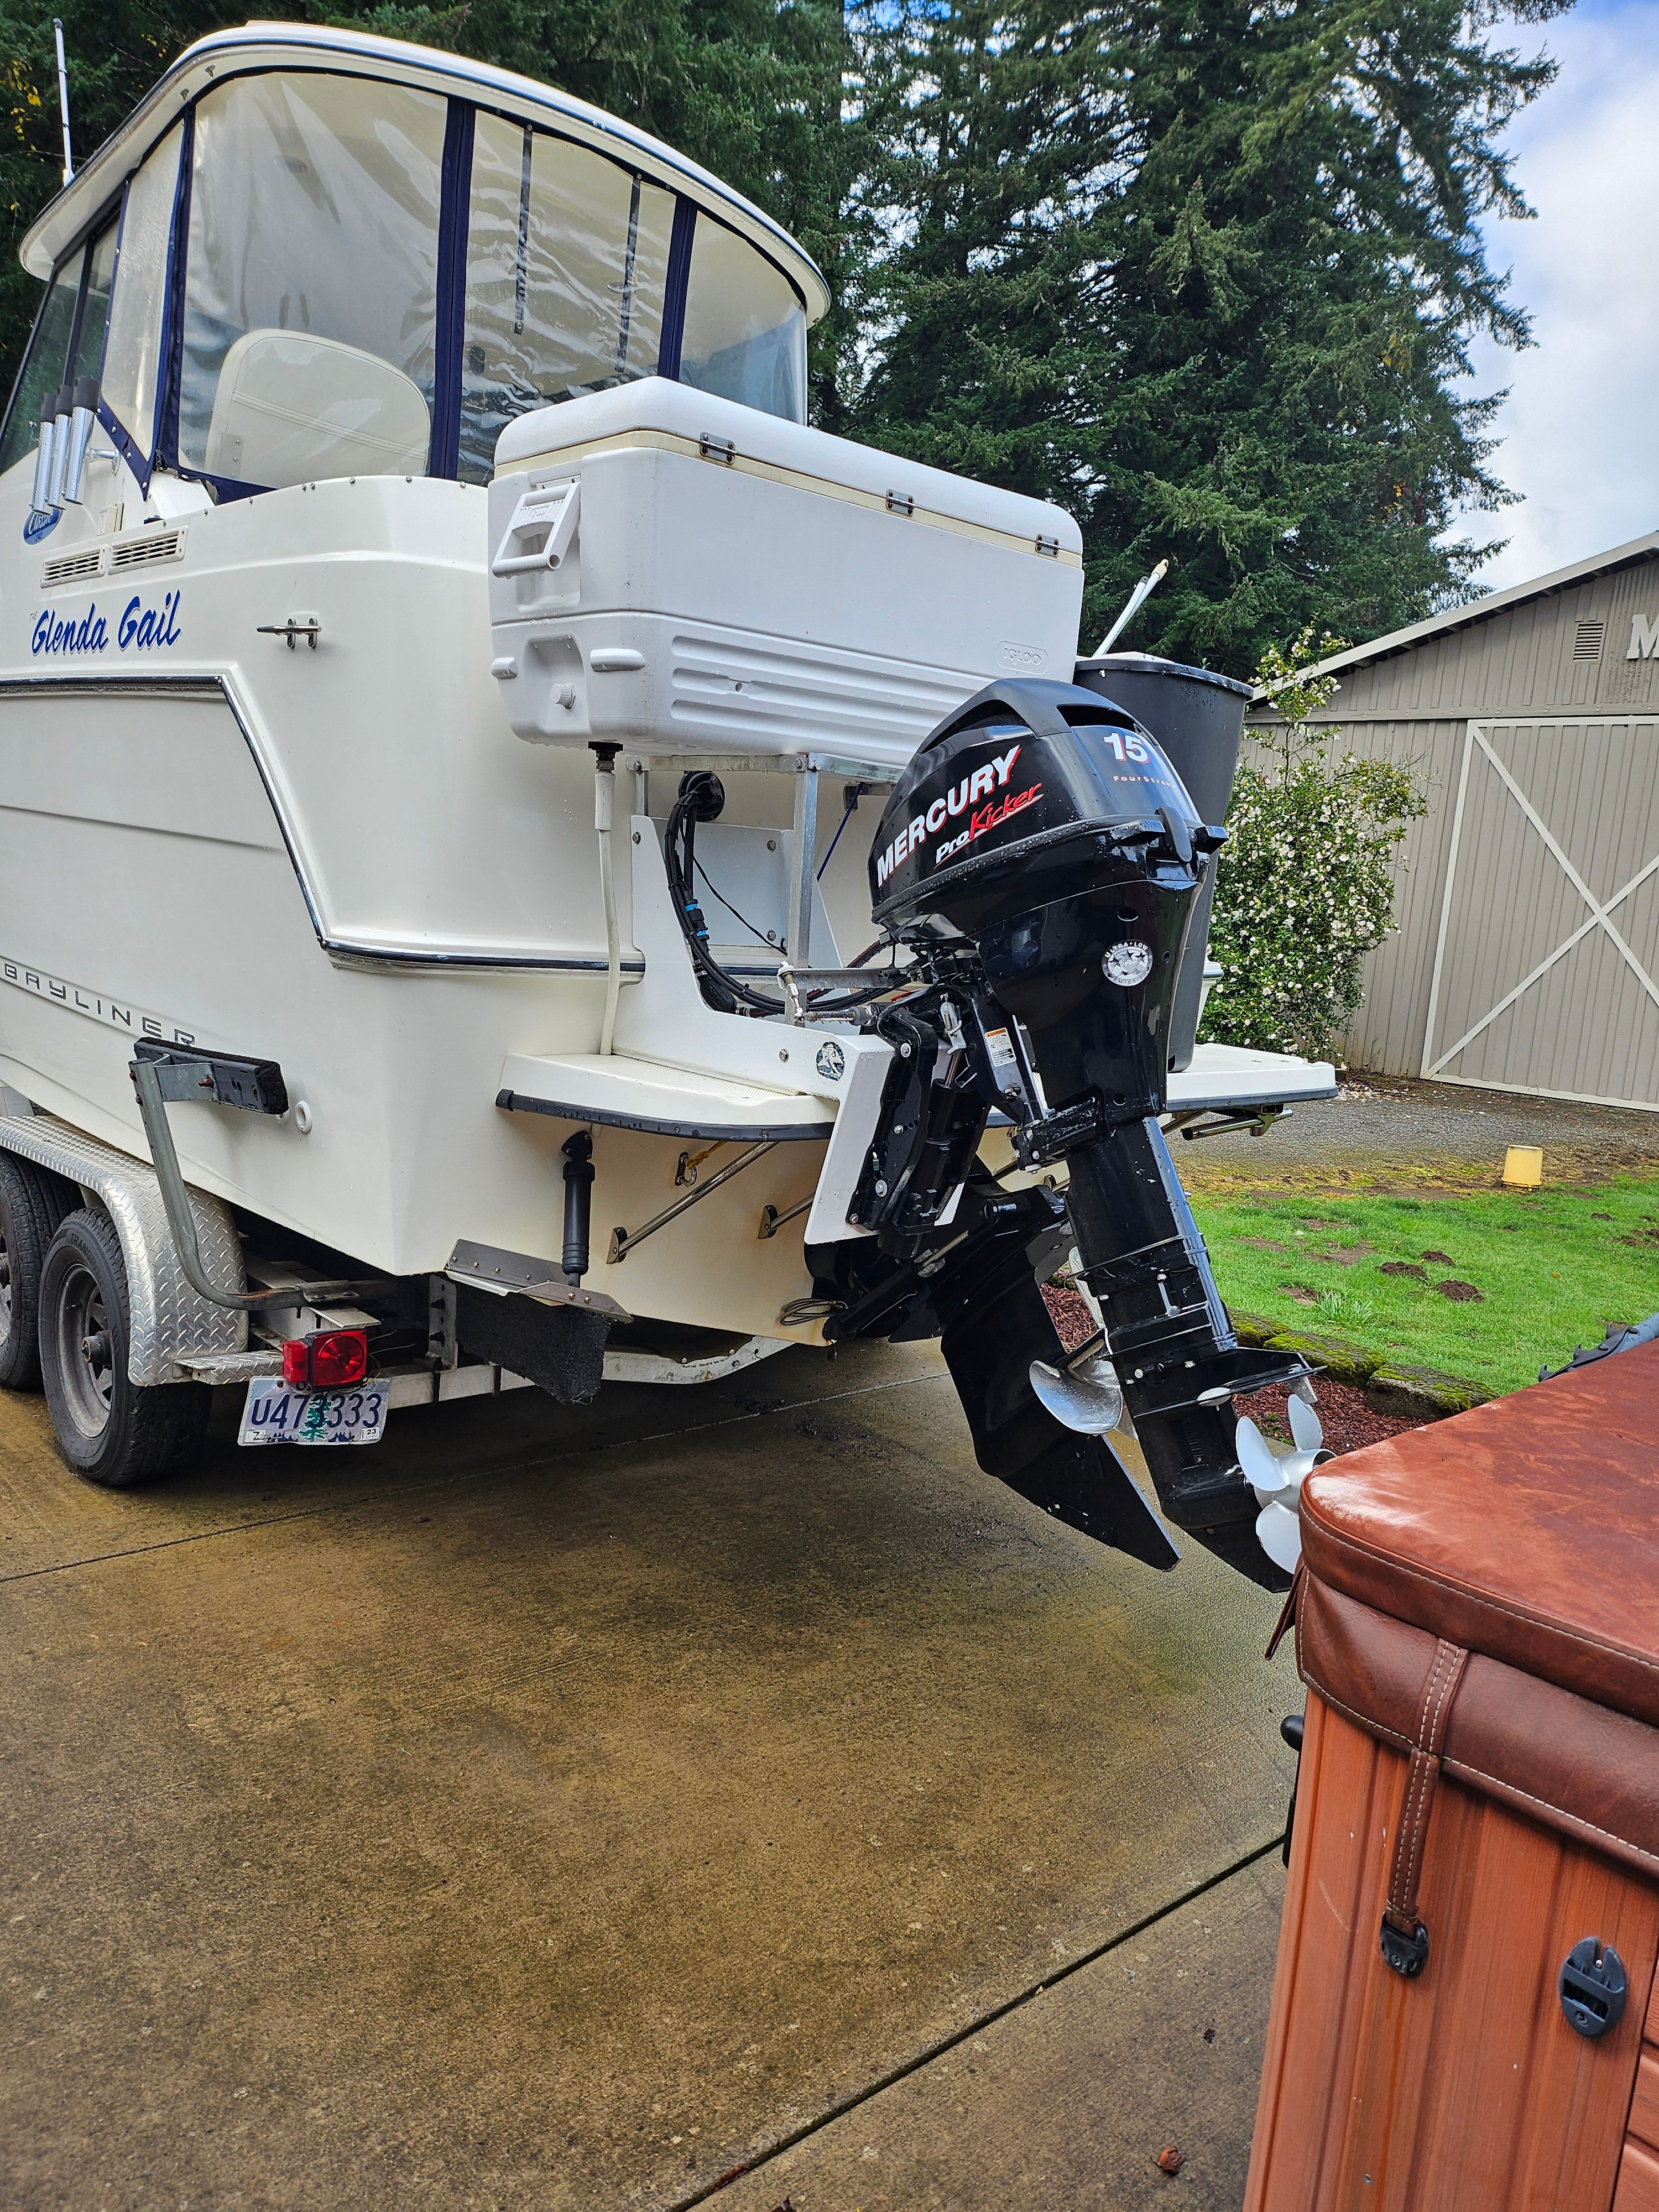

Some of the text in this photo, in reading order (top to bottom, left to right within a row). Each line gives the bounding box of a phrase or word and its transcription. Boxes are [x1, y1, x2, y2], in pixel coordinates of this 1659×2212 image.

[32, 602, 109, 656] Glenda
[118, 589, 181, 651] Gail
[1626, 613, 1659, 659] M
[1104, 733, 1150, 765] 15
[877, 744, 1022, 888] MERCURY
[4, 963, 195, 1047] BAYLINER
[252, 1393, 382, 1430] U473333
